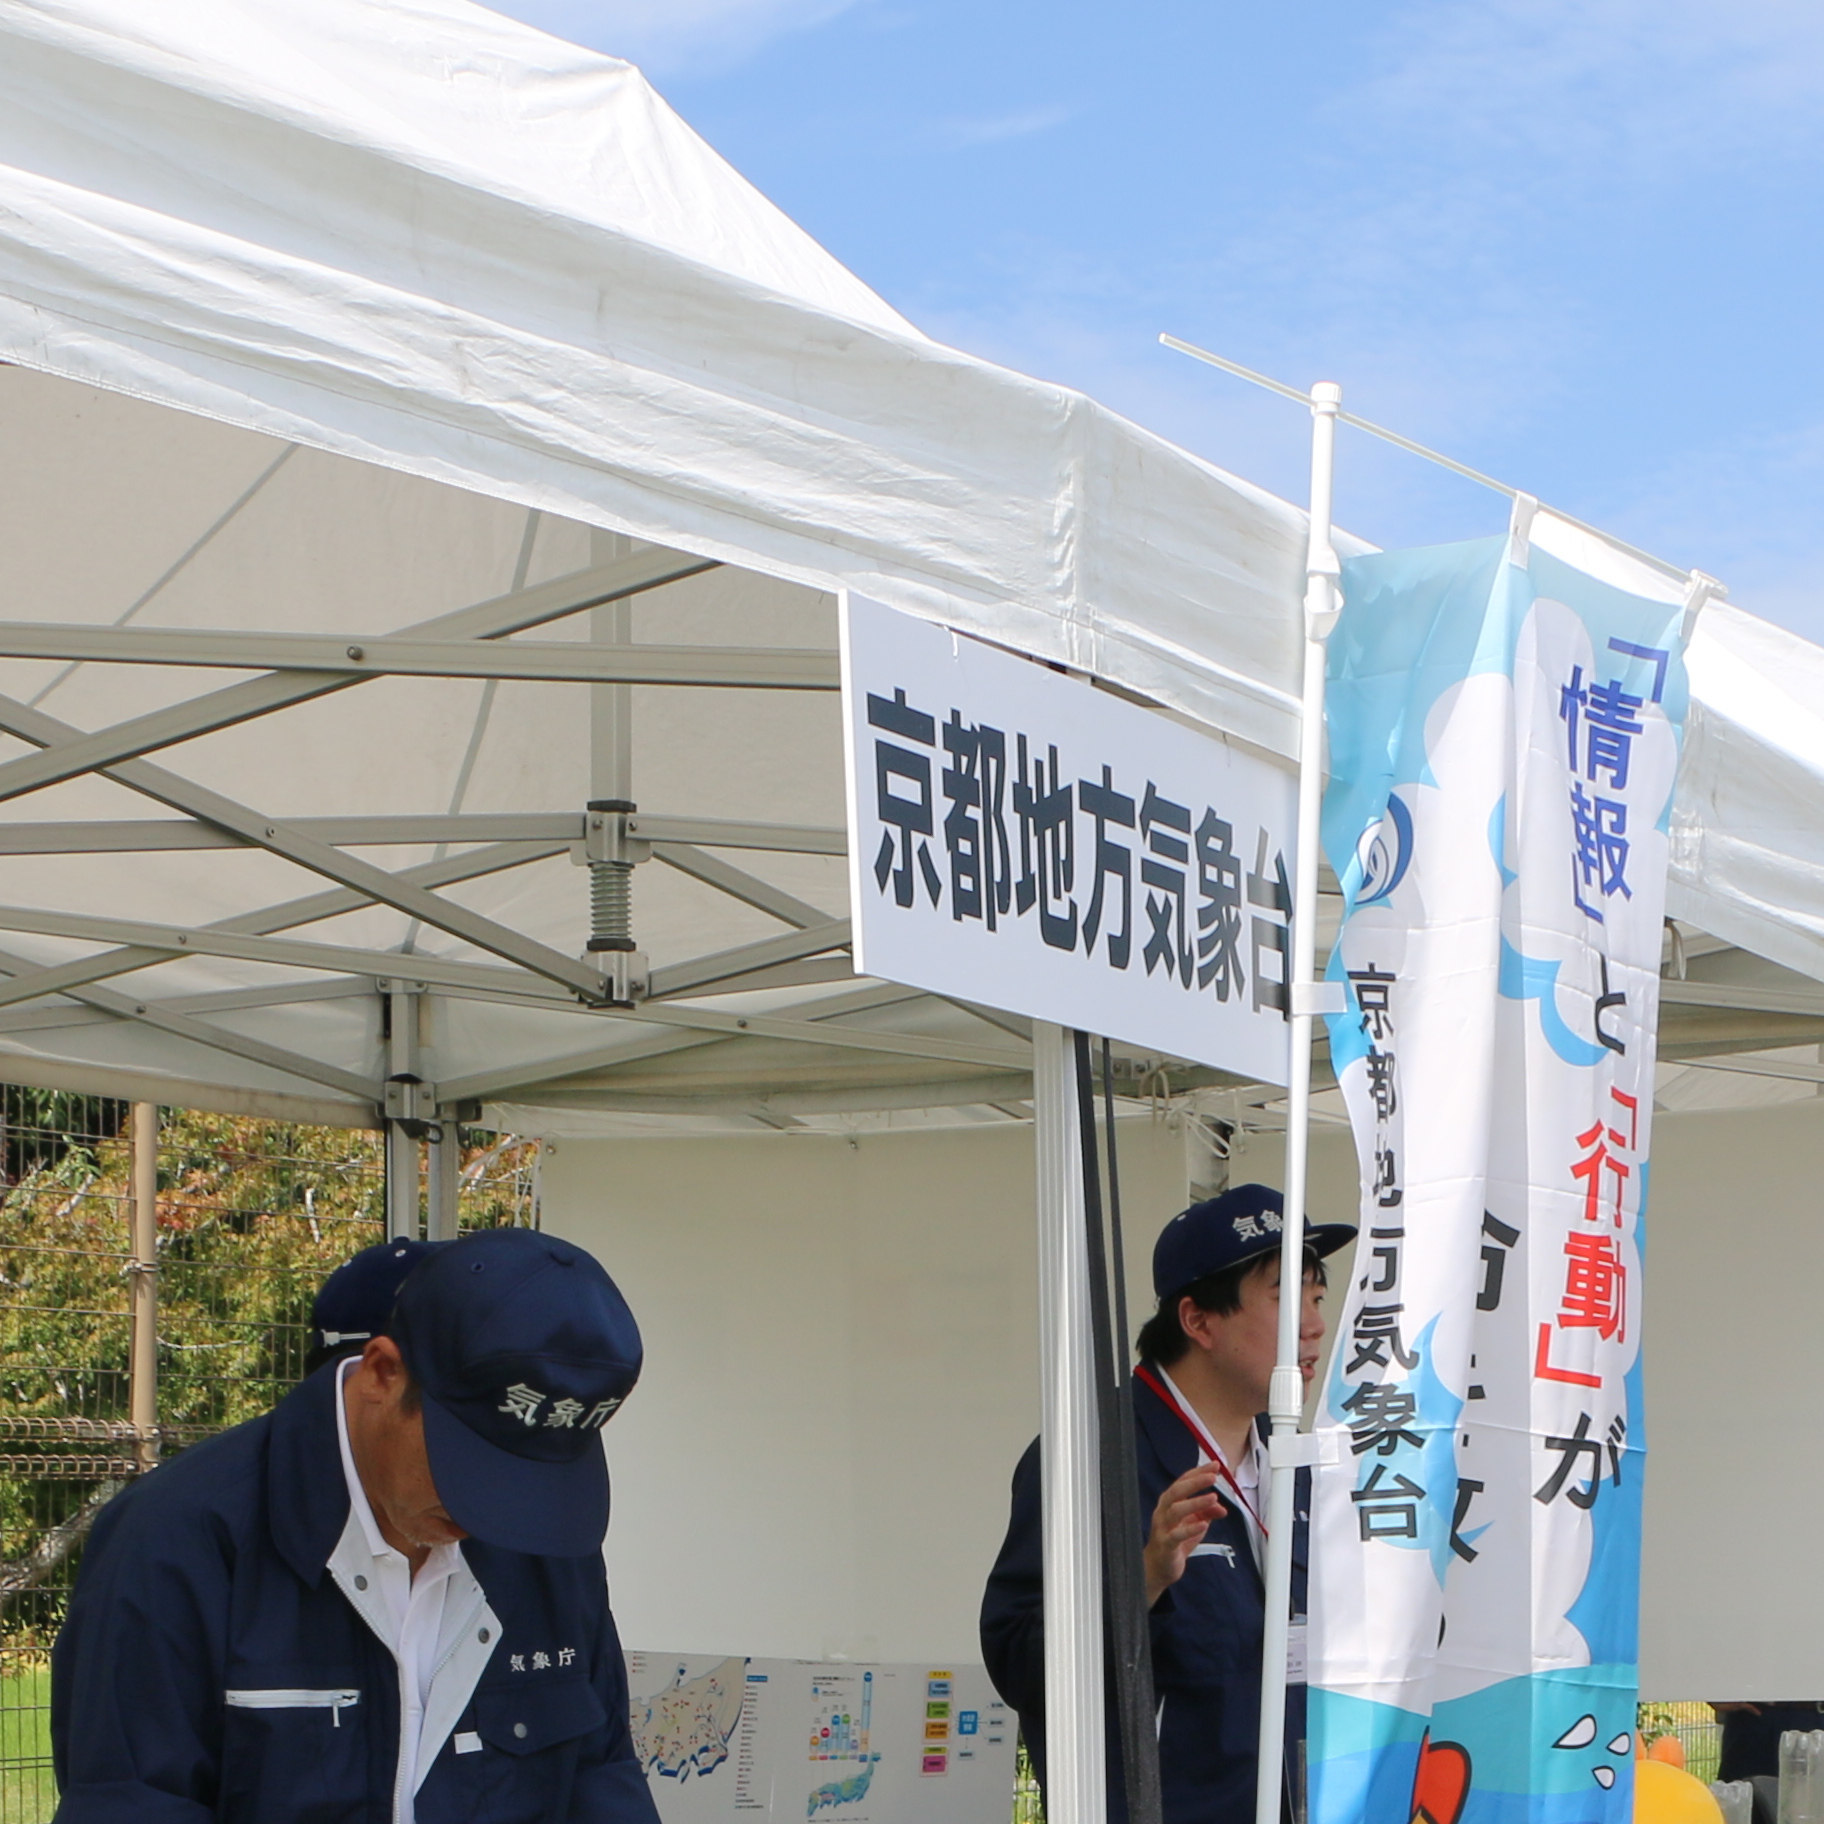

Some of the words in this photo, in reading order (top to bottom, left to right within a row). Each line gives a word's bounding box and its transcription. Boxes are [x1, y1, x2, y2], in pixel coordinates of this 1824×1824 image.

[866, 687, 1294, 1022] 京都地方気象台
[1232, 1209, 1284, 1242] 気象
[498, 1382, 621, 1430] 気象庁
[510, 1647, 576, 1672] 気象庁
